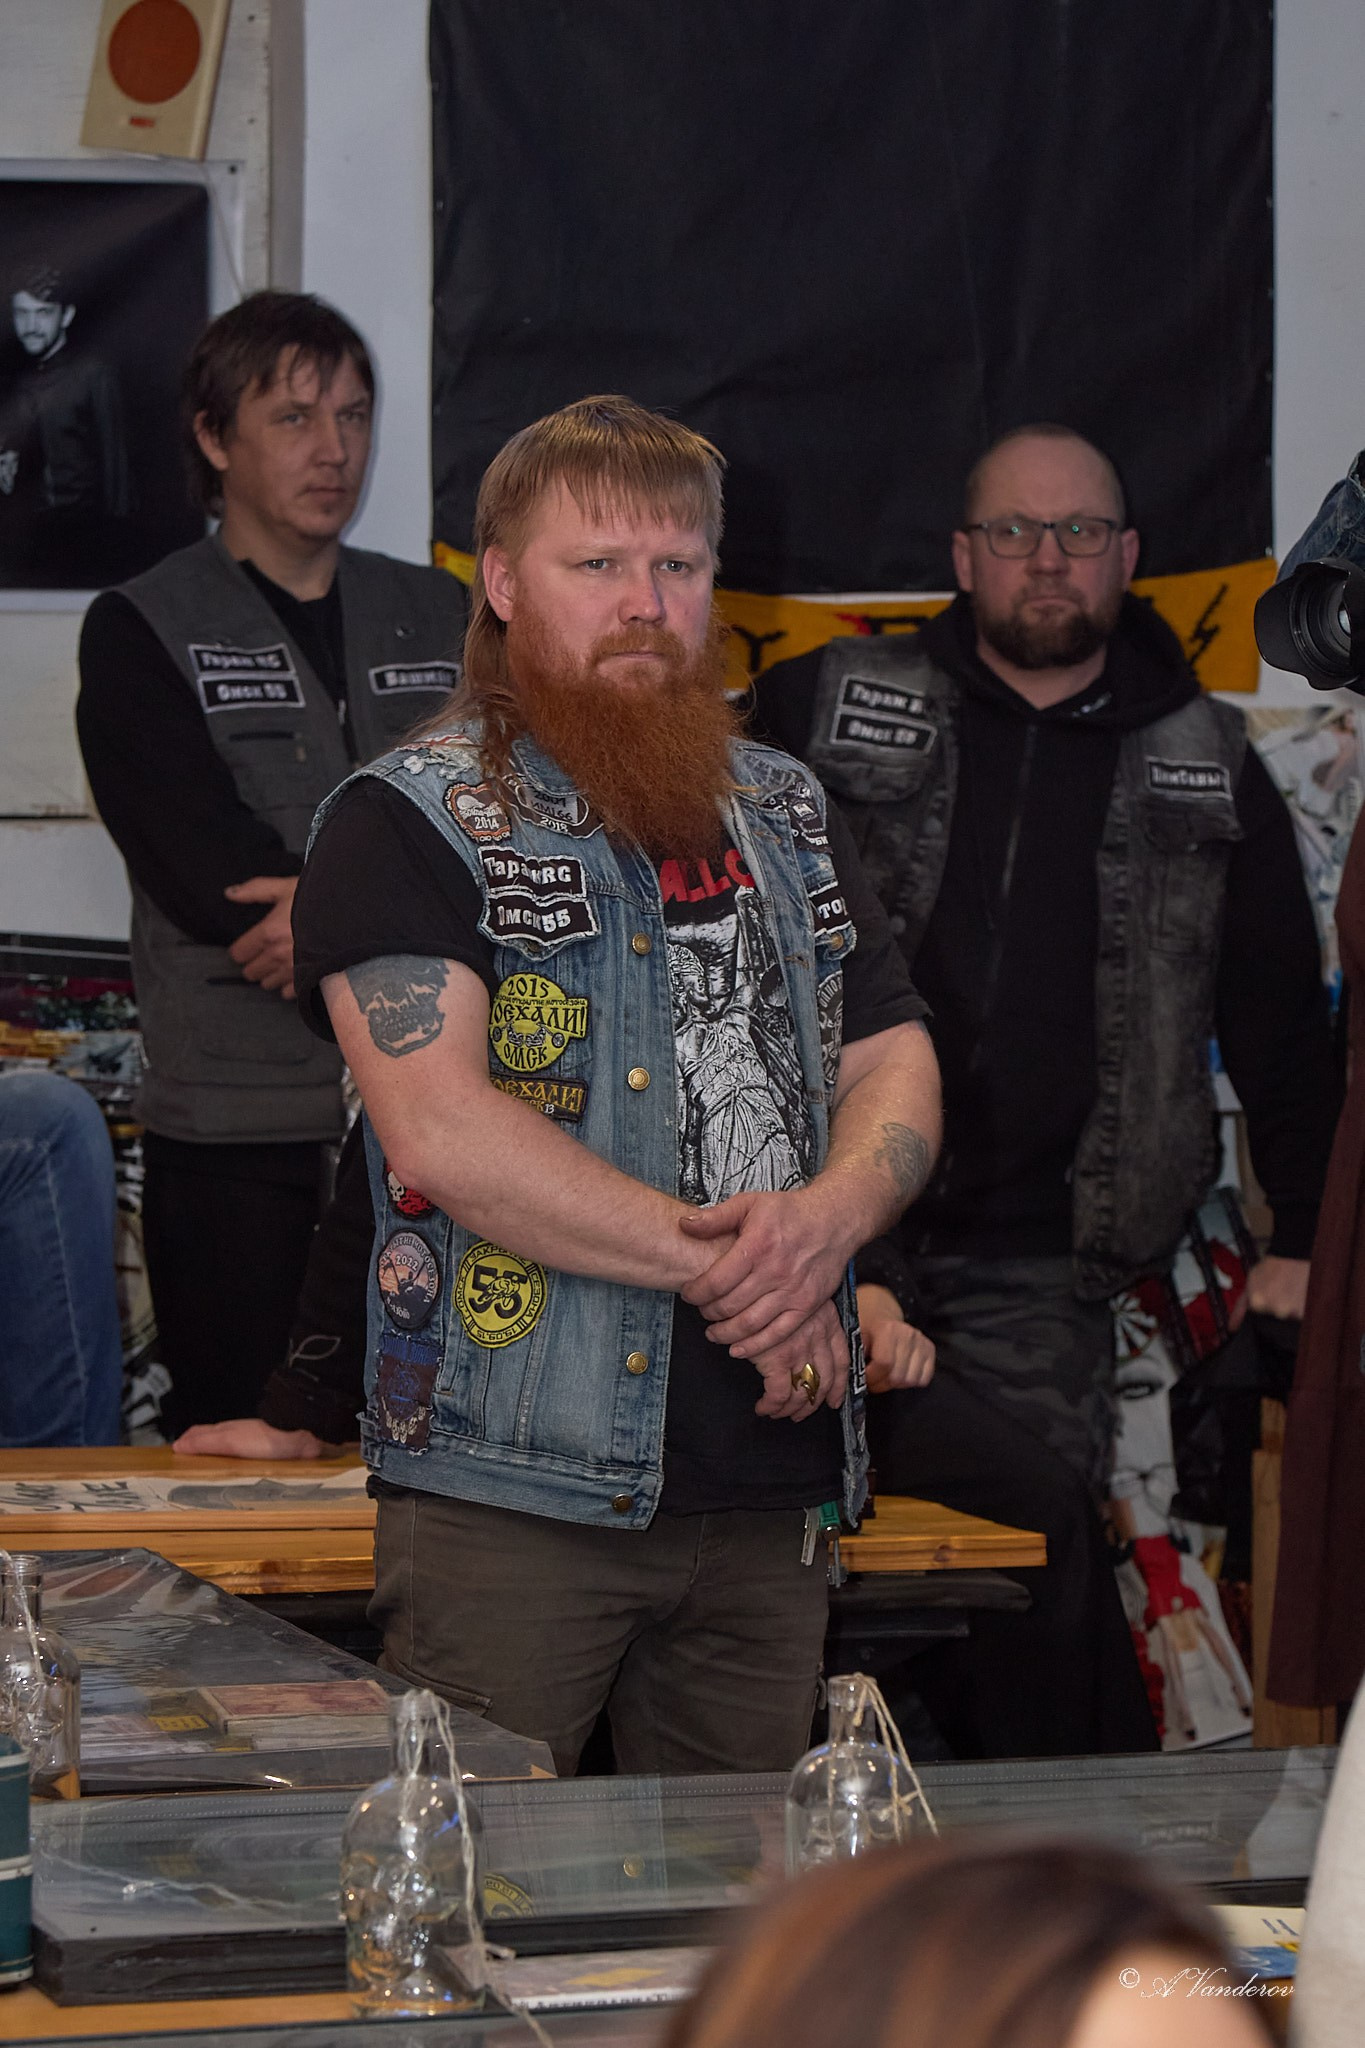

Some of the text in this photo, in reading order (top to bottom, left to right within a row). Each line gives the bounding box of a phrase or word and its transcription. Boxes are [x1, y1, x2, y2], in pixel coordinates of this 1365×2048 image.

[474, 816, 500, 830] 2014
[541, 908, 571, 933] 55
[507, 977, 550, 998] 2015
[489, 1003, 585, 1038] ОЕХАЛИ!
[503, 1043, 548, 1070] ОМСК
[395, 1254, 419, 1272] 2022
[525, 1272, 541, 1318] СЕЗОНА
